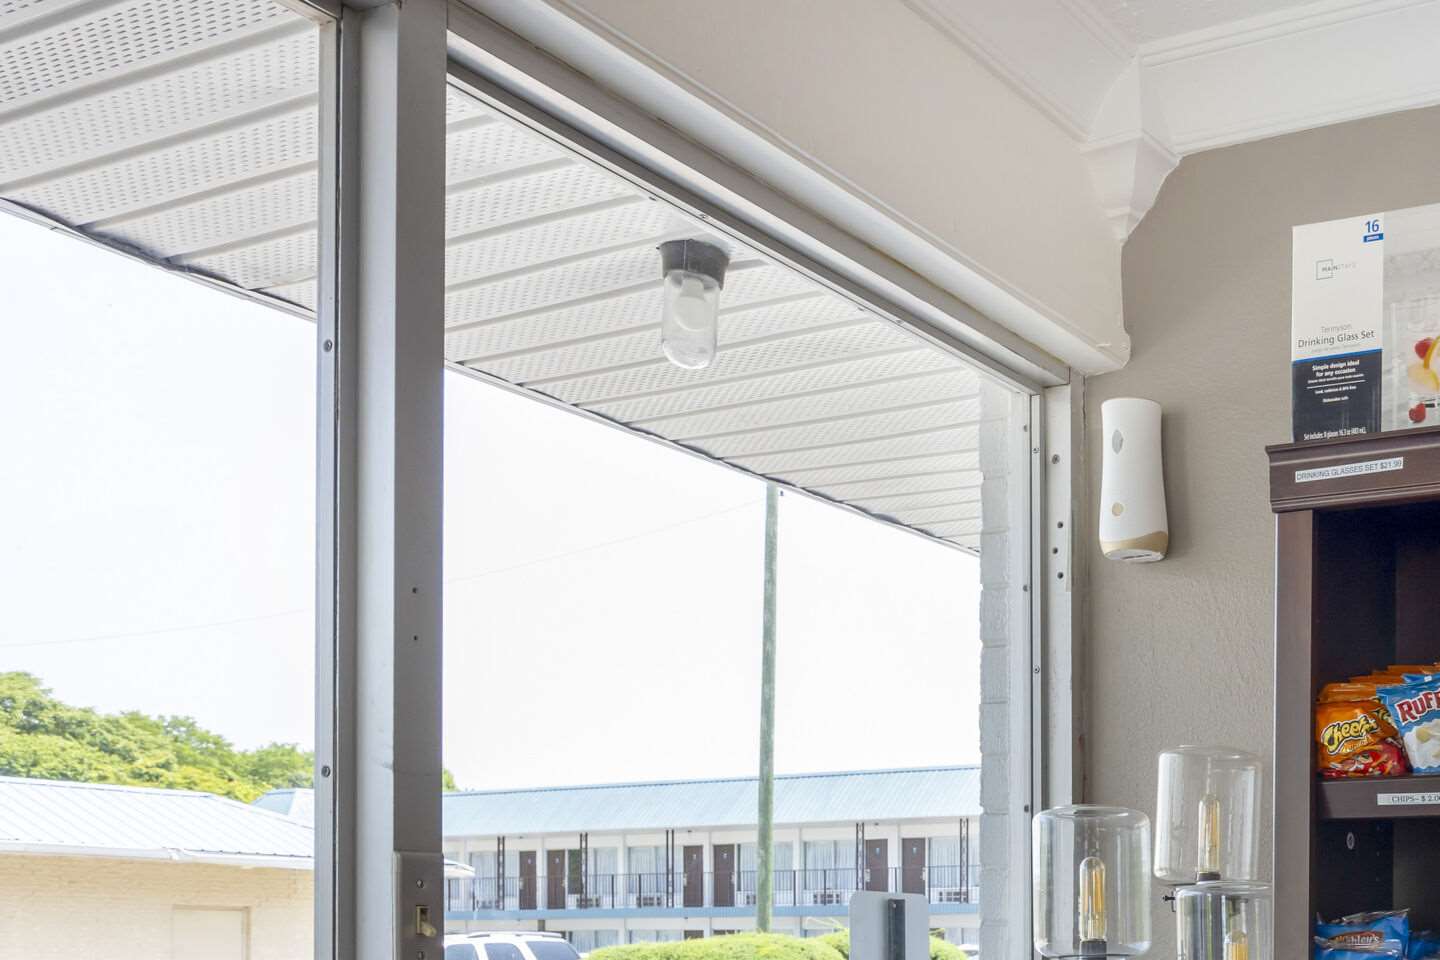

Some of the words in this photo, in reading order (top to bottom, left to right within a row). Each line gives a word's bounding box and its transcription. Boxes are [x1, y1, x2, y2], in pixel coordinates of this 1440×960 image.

[1365, 219, 1380, 233] 16
[1298, 336, 1335, 348] Drinking
[1337, 331, 1359, 343] Glass
[1361, 330, 1375, 339] Set
[1297, 469, 1329, 481] DRINKING
[1331, 465, 1363, 476] GLASSES
[1365, 463, 1378, 472] SET
